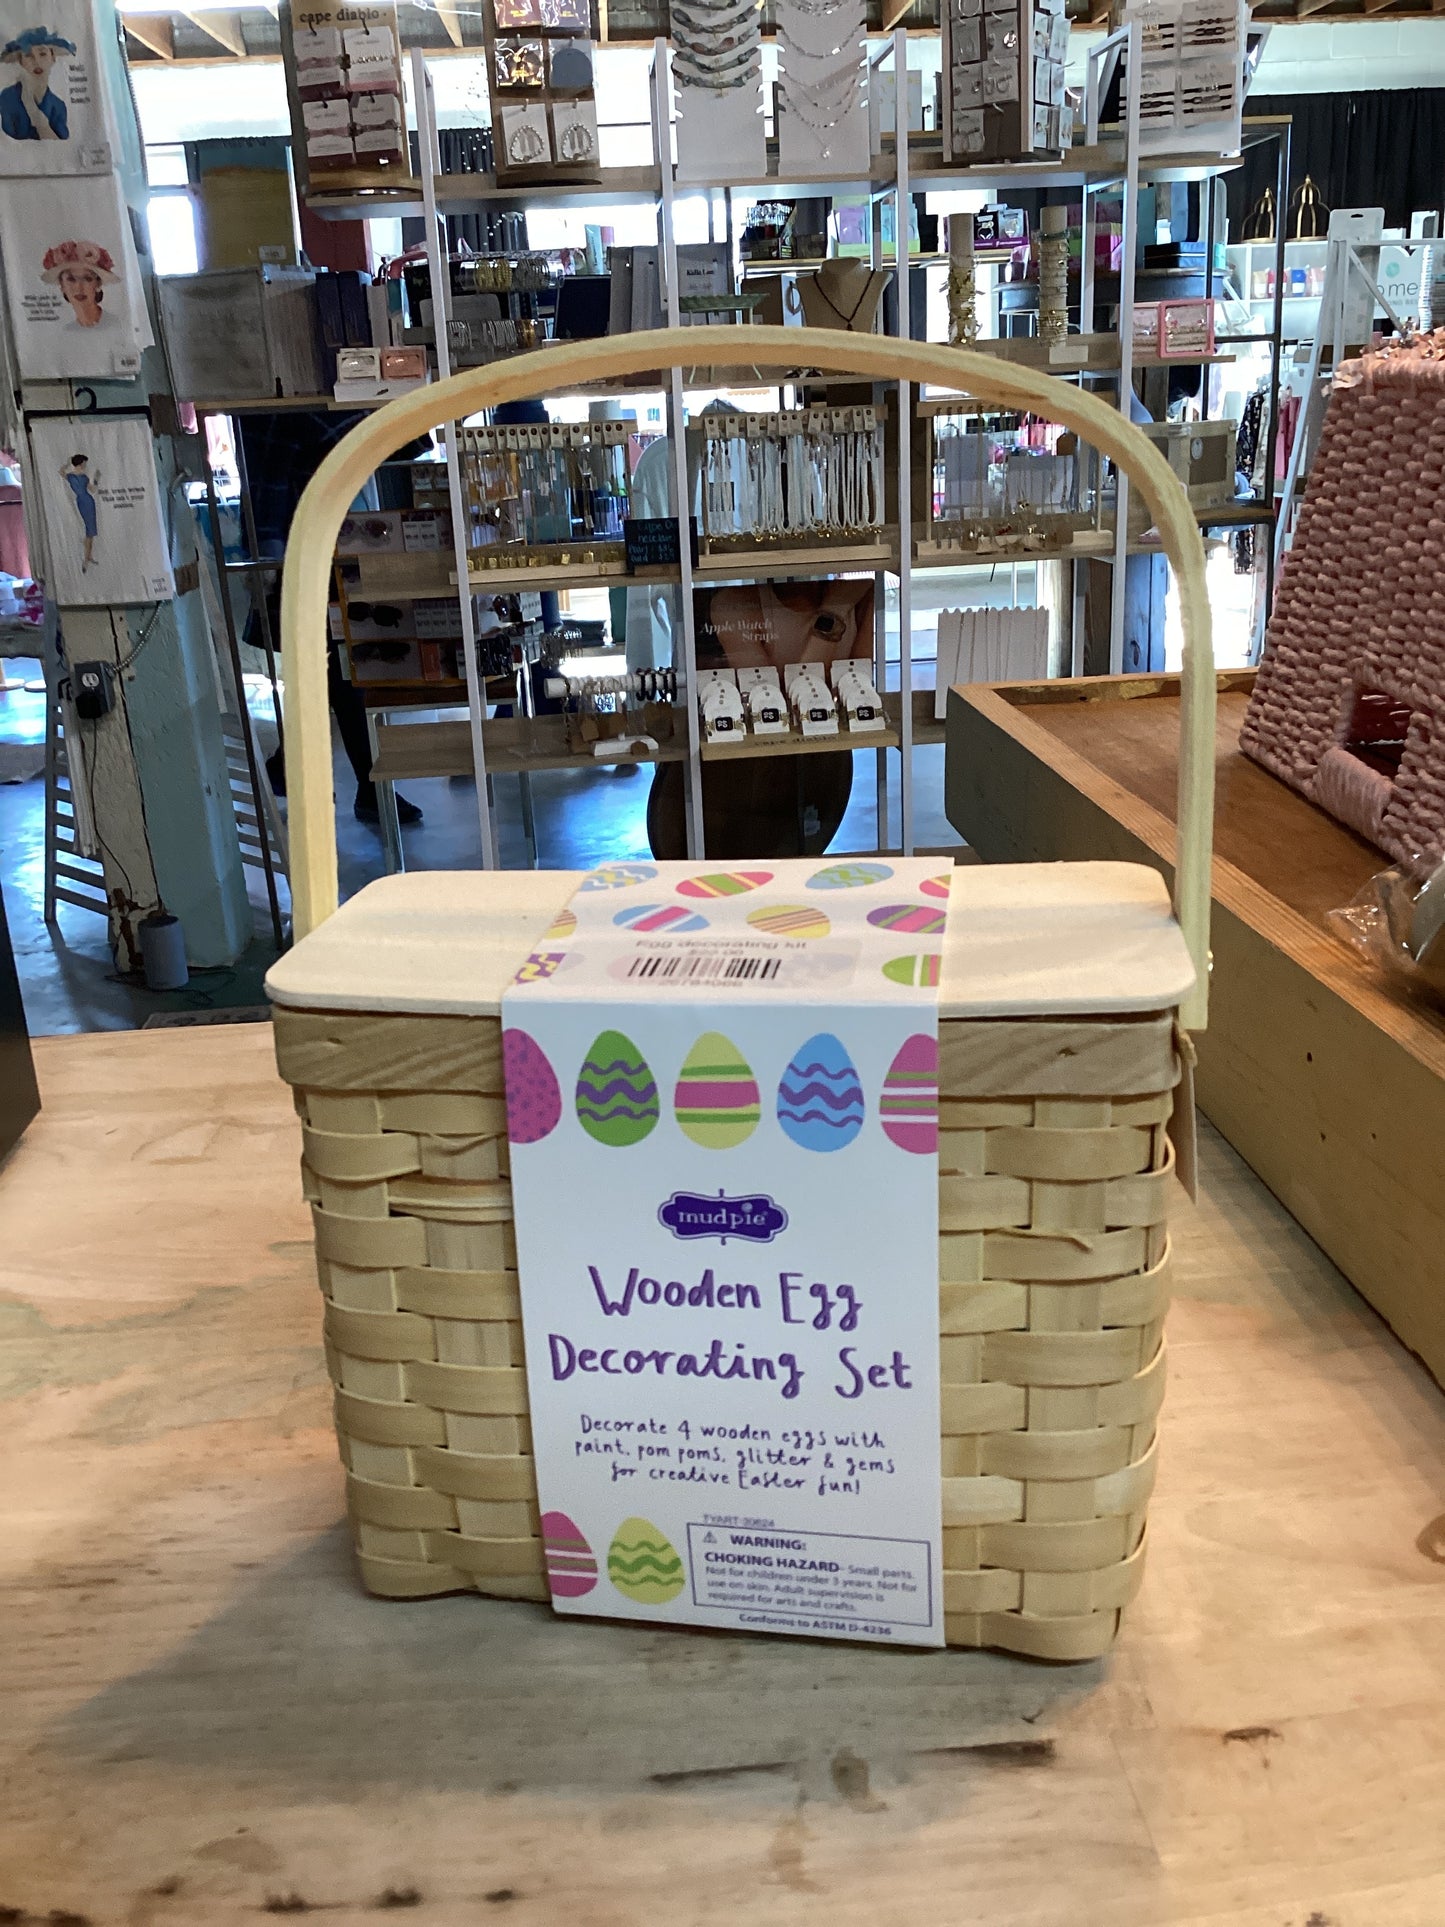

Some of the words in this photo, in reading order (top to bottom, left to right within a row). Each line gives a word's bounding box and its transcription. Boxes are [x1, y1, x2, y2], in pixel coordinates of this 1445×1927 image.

[299, 12, 332, 25] cape
[336, 8, 380, 21] diablo
[700, 621, 734, 635] Apple
[737, 618, 772, 630] Watch
[742, 631, 780, 642] Straps
[588, 1265, 761, 1316] Wooden
[779, 1272, 863, 1331] Egg
[548, 1333, 805, 1399] Decorating
[834, 1347, 912, 1399] Set
[580, 1414, 667, 1434] Decorate
[677, 1420, 691, 1440] 4
[700, 1423, 771, 1440] wooden
[781, 1430, 826, 1450] eggs
[834, 1431, 885, 1448] with
[637, 1444, 670, 1461] pom
[736, 1448, 811, 1469] glitter
[823, 1452, 835, 1468] &
[846, 1457, 895, 1476] gems
[611, 1461, 637, 1482] for
[649, 1465, 730, 1485] creative
[738, 1469, 806, 1490] Easter
[818, 1475, 860, 1496] fun!
[730, 1534, 807, 1550] WARNING:
[704, 1551, 773, 1567] CHOKING
[848, 1565, 879, 1576] Small
[705, 1566, 726, 1574] Not
[729, 1567, 744, 1576] for
[747, 1569, 793, 1580] children
[796, 1575, 829, 1584] under
[877, 1581, 898, 1590] Not
[901, 1582, 917, 1592] for
[707, 1592, 755, 1602] required
[757, 1594, 772, 1603] for
[799, 1599, 821, 1608] and
[774, 1584, 804, 1594] Adult
[808, 1589, 873, 1600] supervision
[739, 1613, 795, 1626] Conforms
[797, 1619, 810, 1628] to
[812, 1620, 847, 1631] ASTM
